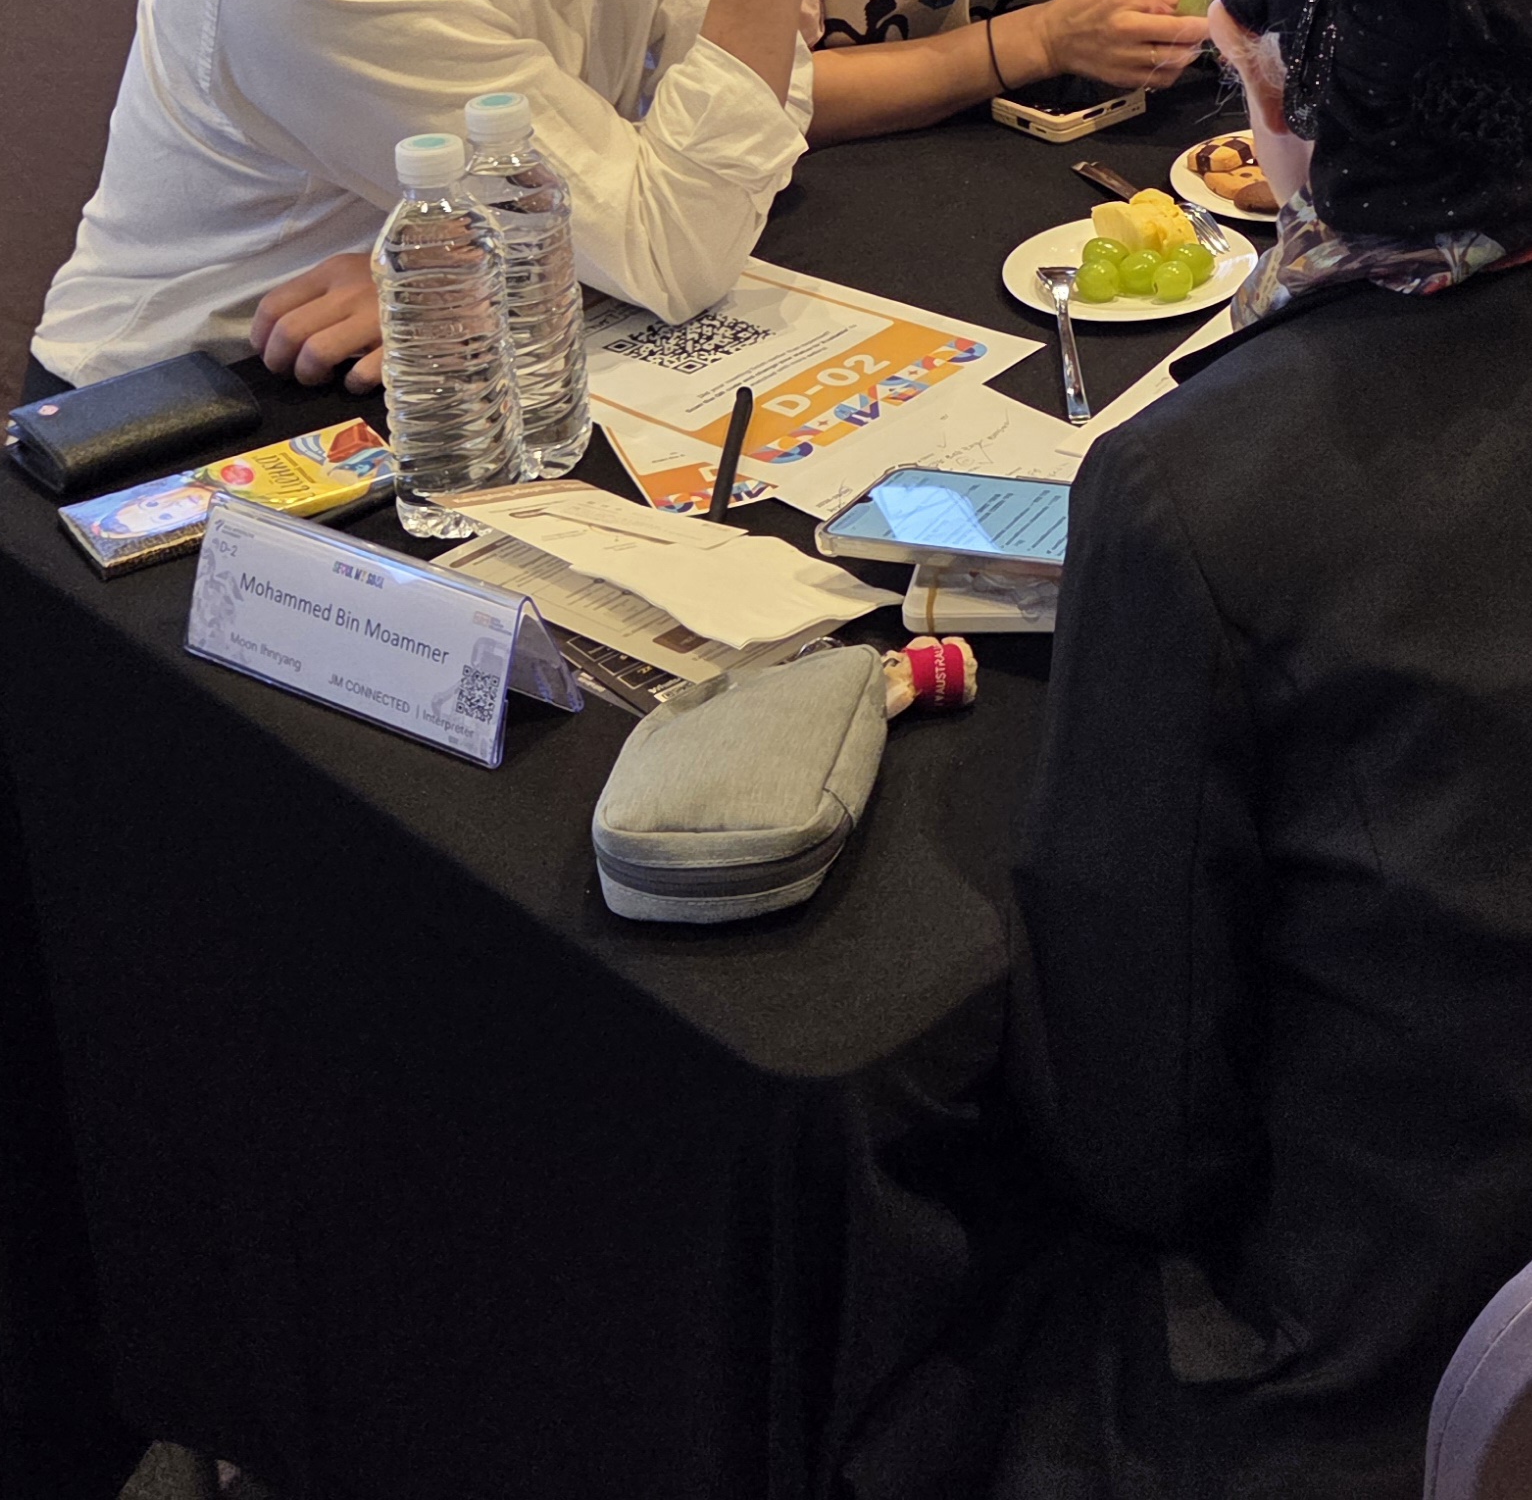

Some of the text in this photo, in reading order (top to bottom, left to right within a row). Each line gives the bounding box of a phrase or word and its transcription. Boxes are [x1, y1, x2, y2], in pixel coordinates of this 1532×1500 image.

[761, 354, 891, 418] D-02
[219, 541, 239, 557] D-2
[240, 572, 333, 621] Mohammed
[335, 608, 360, 633] Bin
[364, 618, 449, 664] Moammer
[345, 679, 411, 714] CONNECTED
[422, 709, 476, 739] Interpreter
